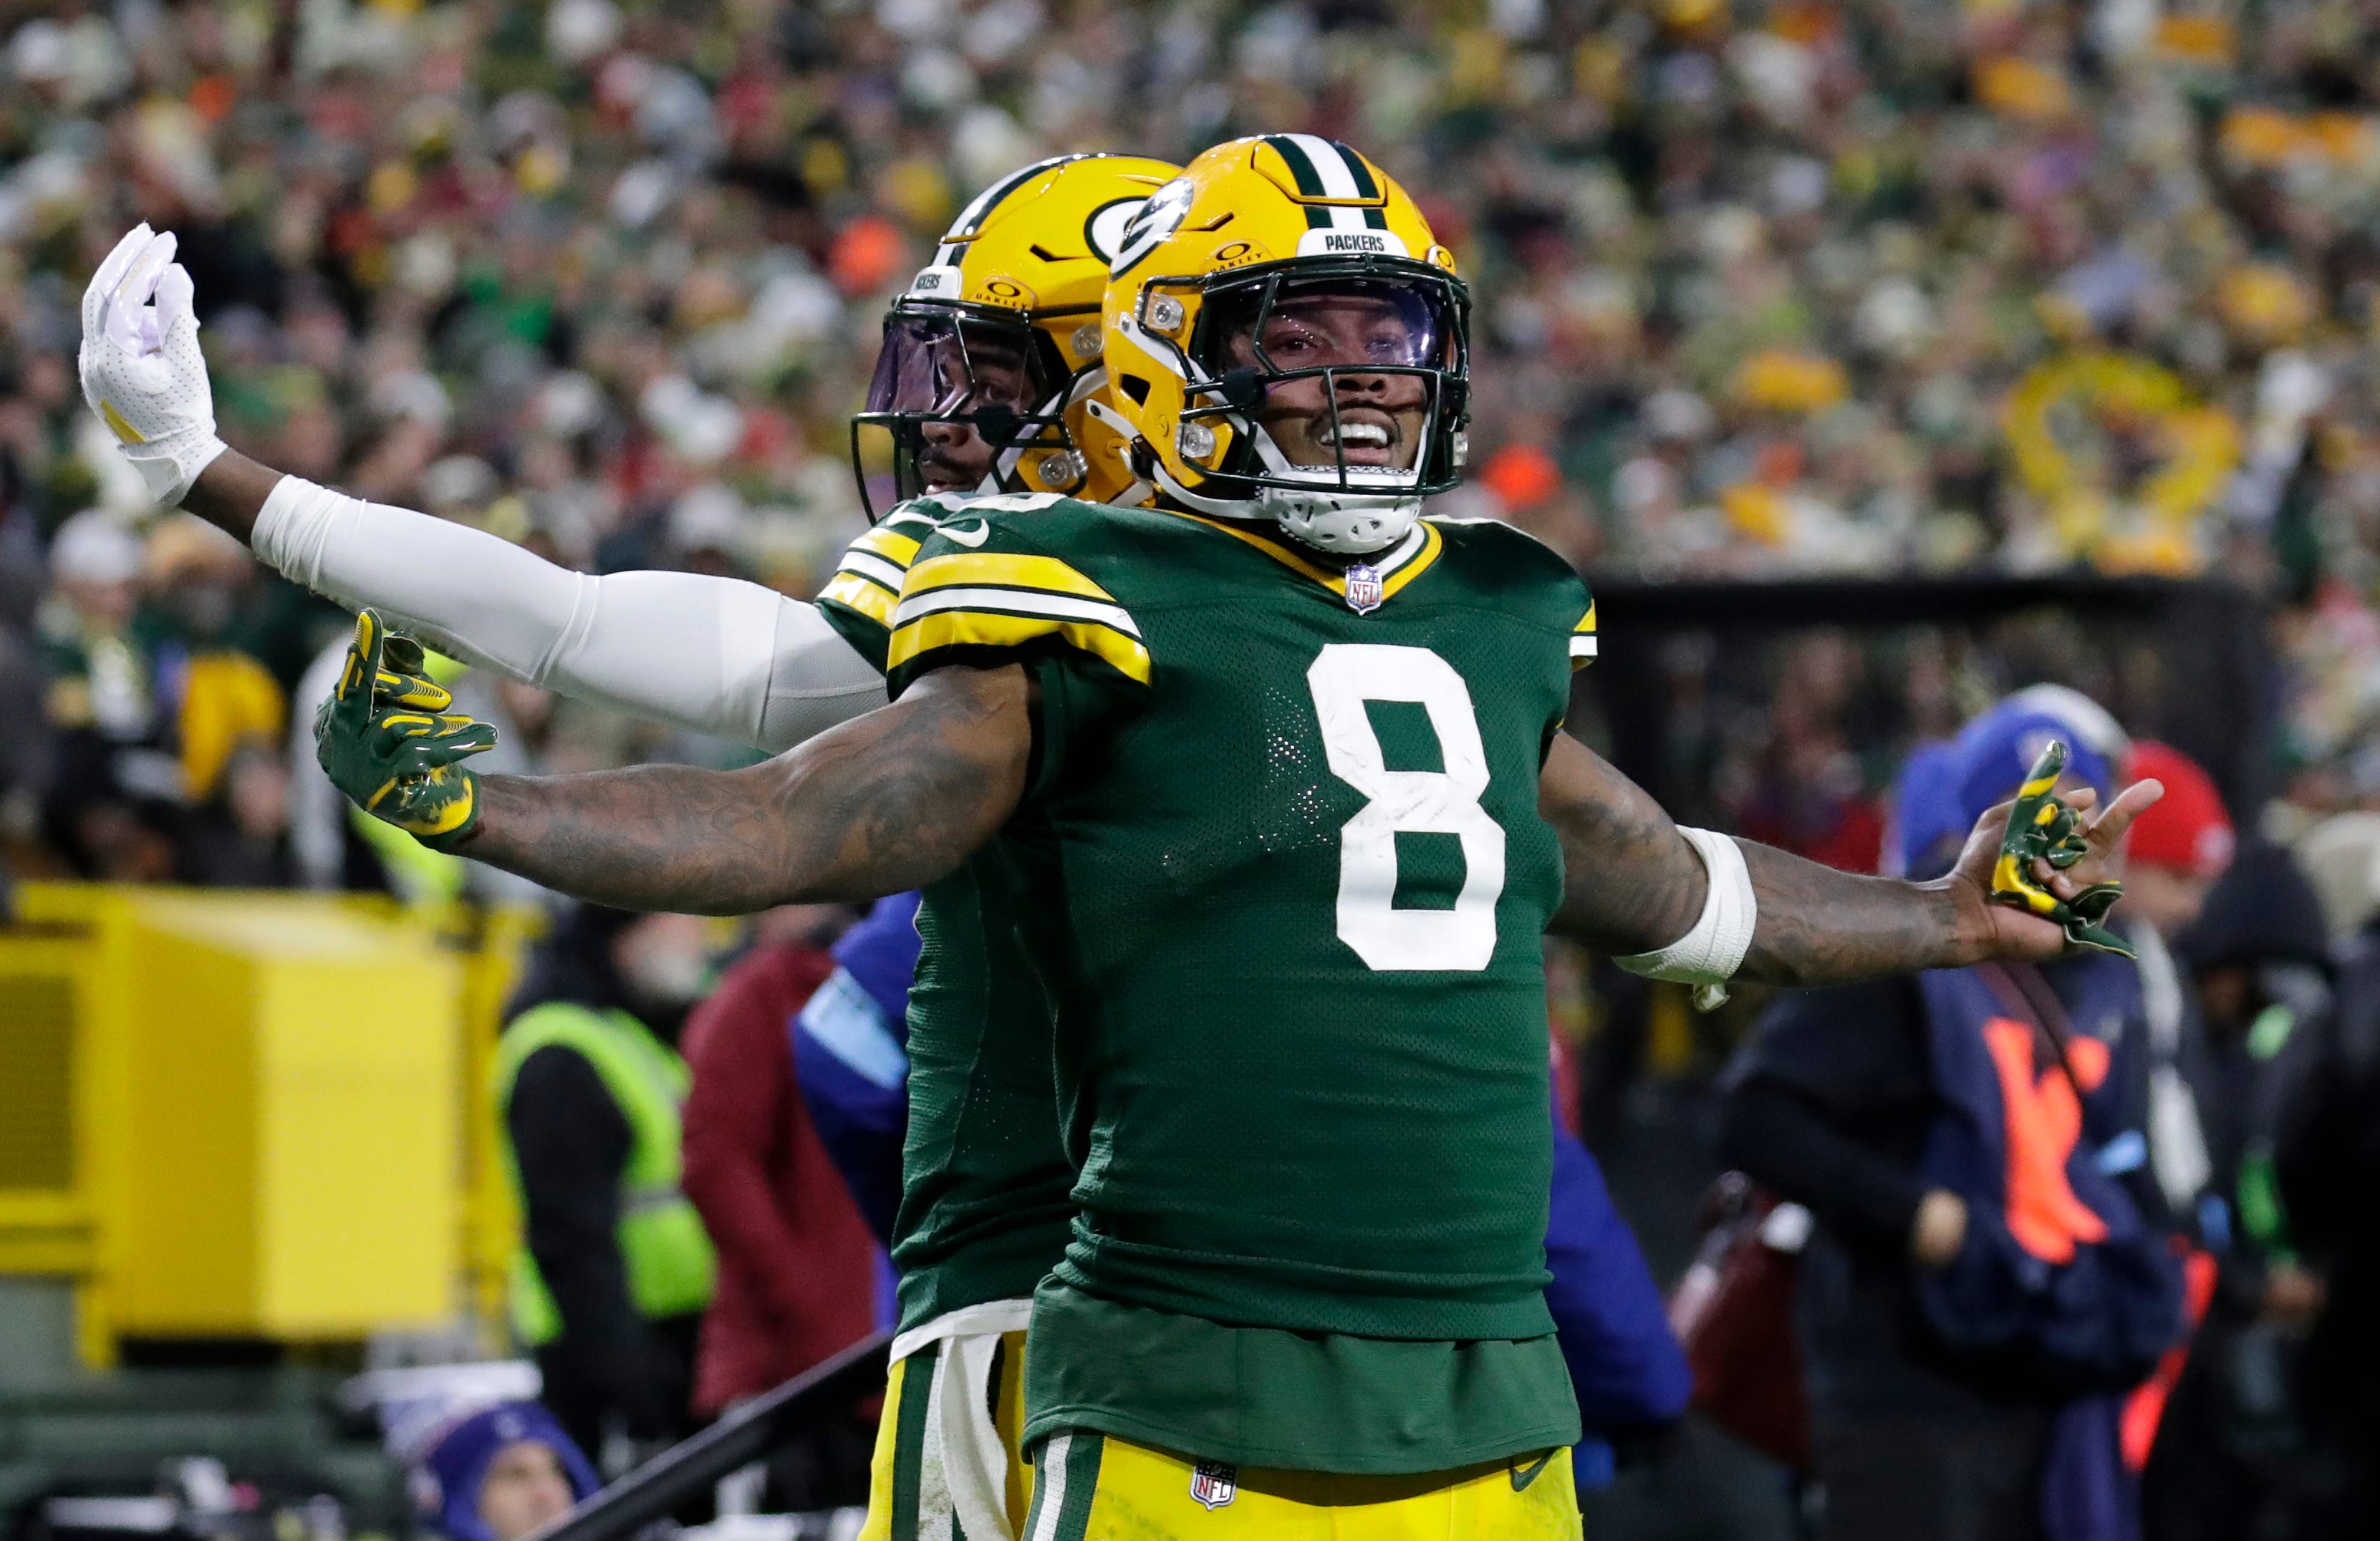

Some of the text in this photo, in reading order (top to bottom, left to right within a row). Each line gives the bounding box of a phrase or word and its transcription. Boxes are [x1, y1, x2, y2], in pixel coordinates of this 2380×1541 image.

[1325, 234, 1385, 251] PACKERS
[1210, 252, 1262, 273] OAKLEY
[975, 293, 1027, 311] OAKLEY
[1352, 583, 1377, 605] NFL
[1306, 643, 1505, 972] 8
[1198, 1475, 1228, 1499] NFL
